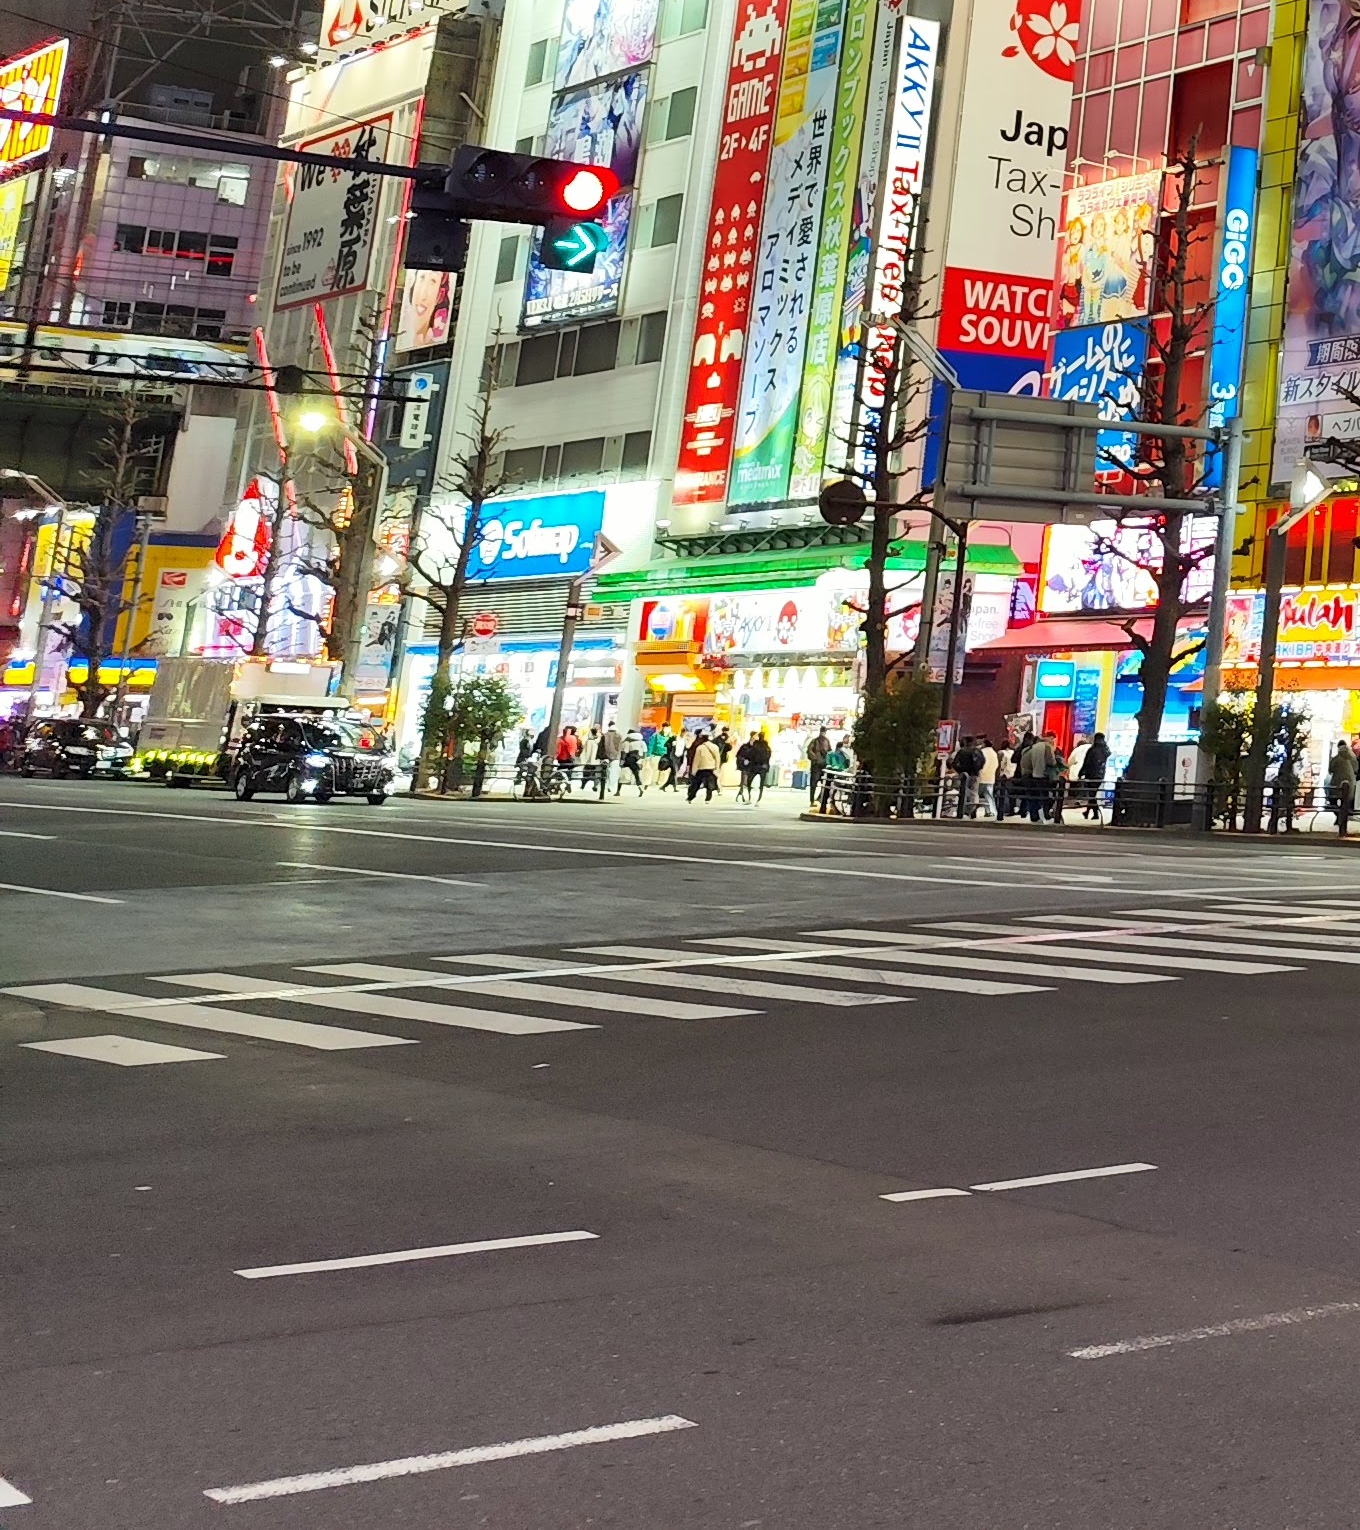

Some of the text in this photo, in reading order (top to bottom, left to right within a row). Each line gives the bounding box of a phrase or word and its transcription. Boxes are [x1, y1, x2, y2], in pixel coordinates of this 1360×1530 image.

[727, 73, 775, 123] GAME
[900, 24, 931, 131] AKKY
[720, 131, 769, 163] 2F 4F
[301, 227, 325, 254] 1992
[786, 108, 828, 354] 世界で愛される
[762, 149, 806, 392] メディミックス
[745, 233, 779, 438] アロマソープ
[737, 463, 782, 484] medimix
